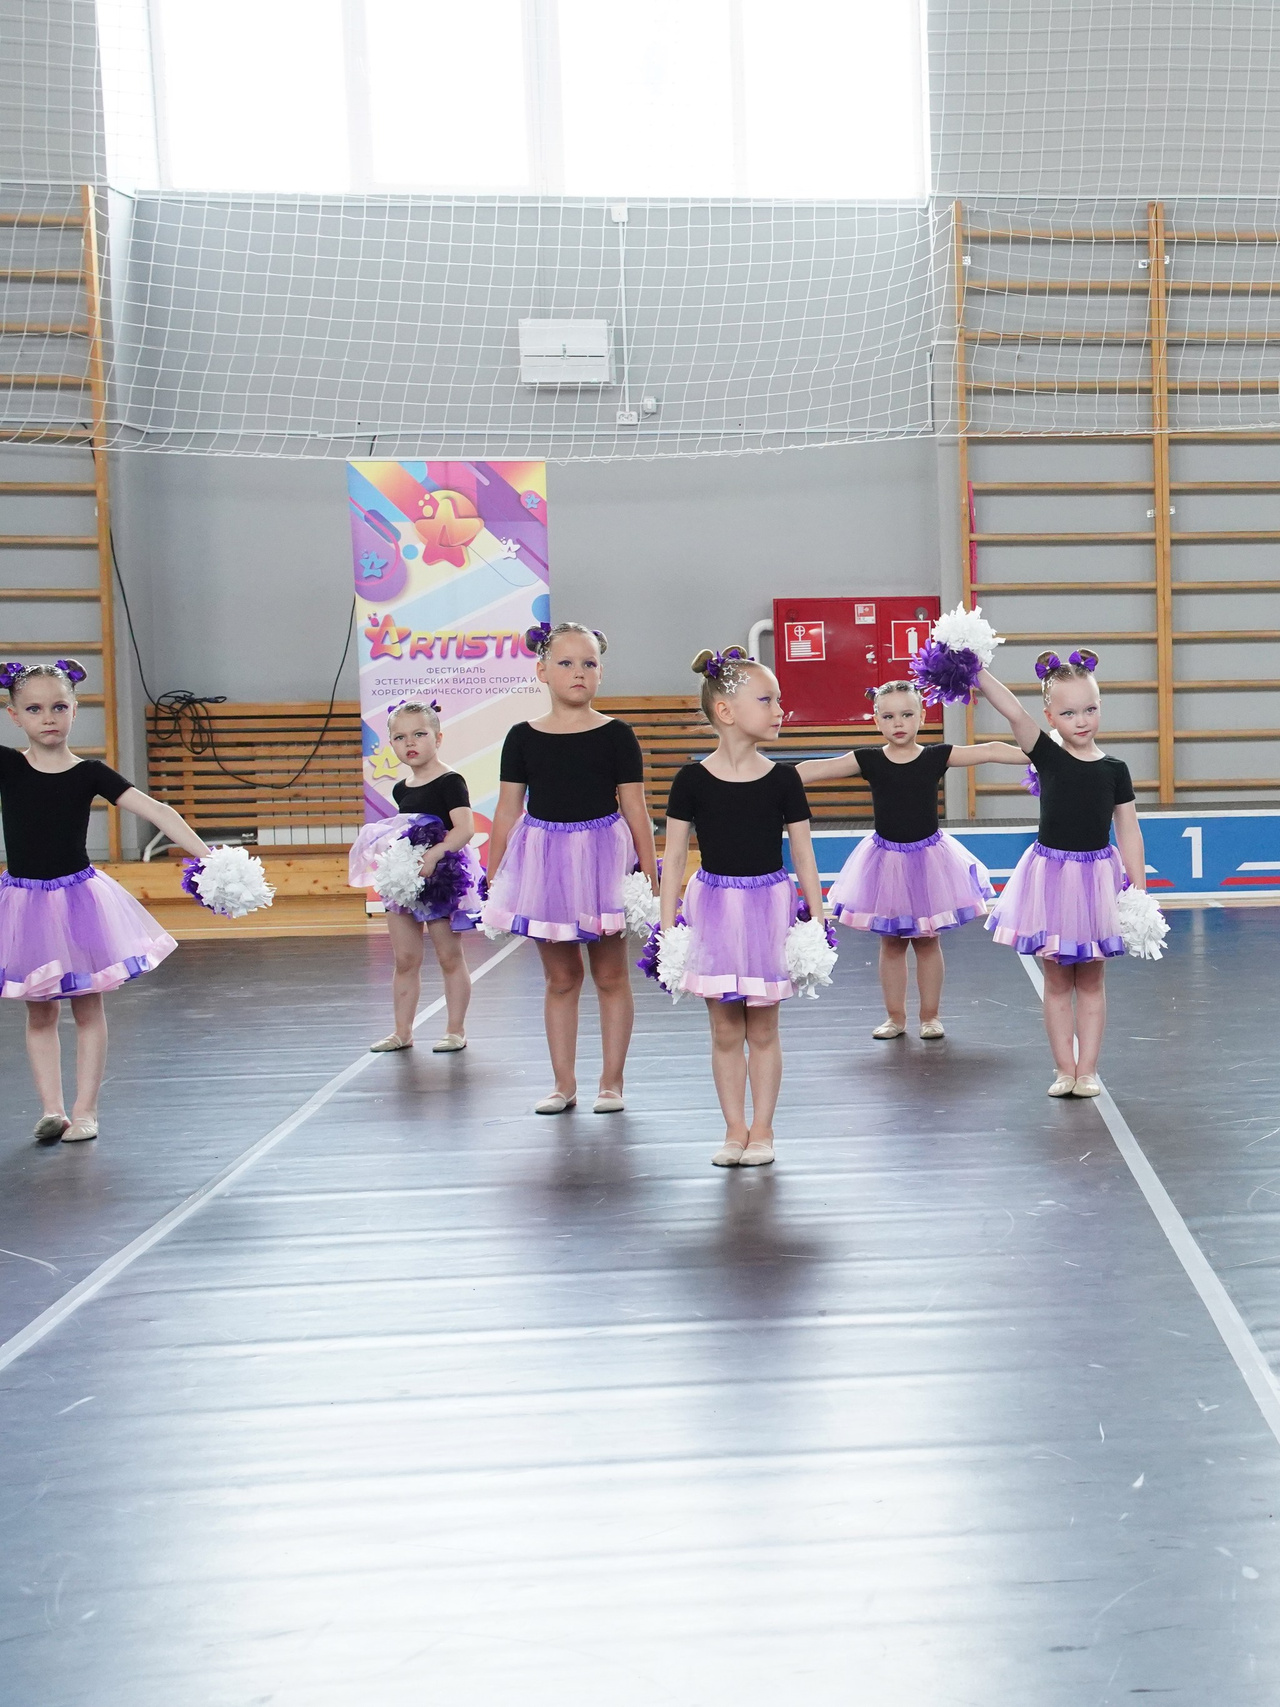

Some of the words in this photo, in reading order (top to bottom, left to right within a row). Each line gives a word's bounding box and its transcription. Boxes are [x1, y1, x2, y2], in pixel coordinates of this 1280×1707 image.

[426, 666, 486, 674] ФЕСТИВАЛЬ
[374, 677, 450, 686] ЭСТЕТИЧЕСКИХ
[452, 677, 487, 685] ВИДОВ
[489, 676, 528, 684] СПОРТА
[371, 687, 483, 696] ХОРЕОГРАФИЧЕСКОГО
[485, 686, 542, 695] ИСКУССТВА
[1181, 826, 1203, 878] 1
